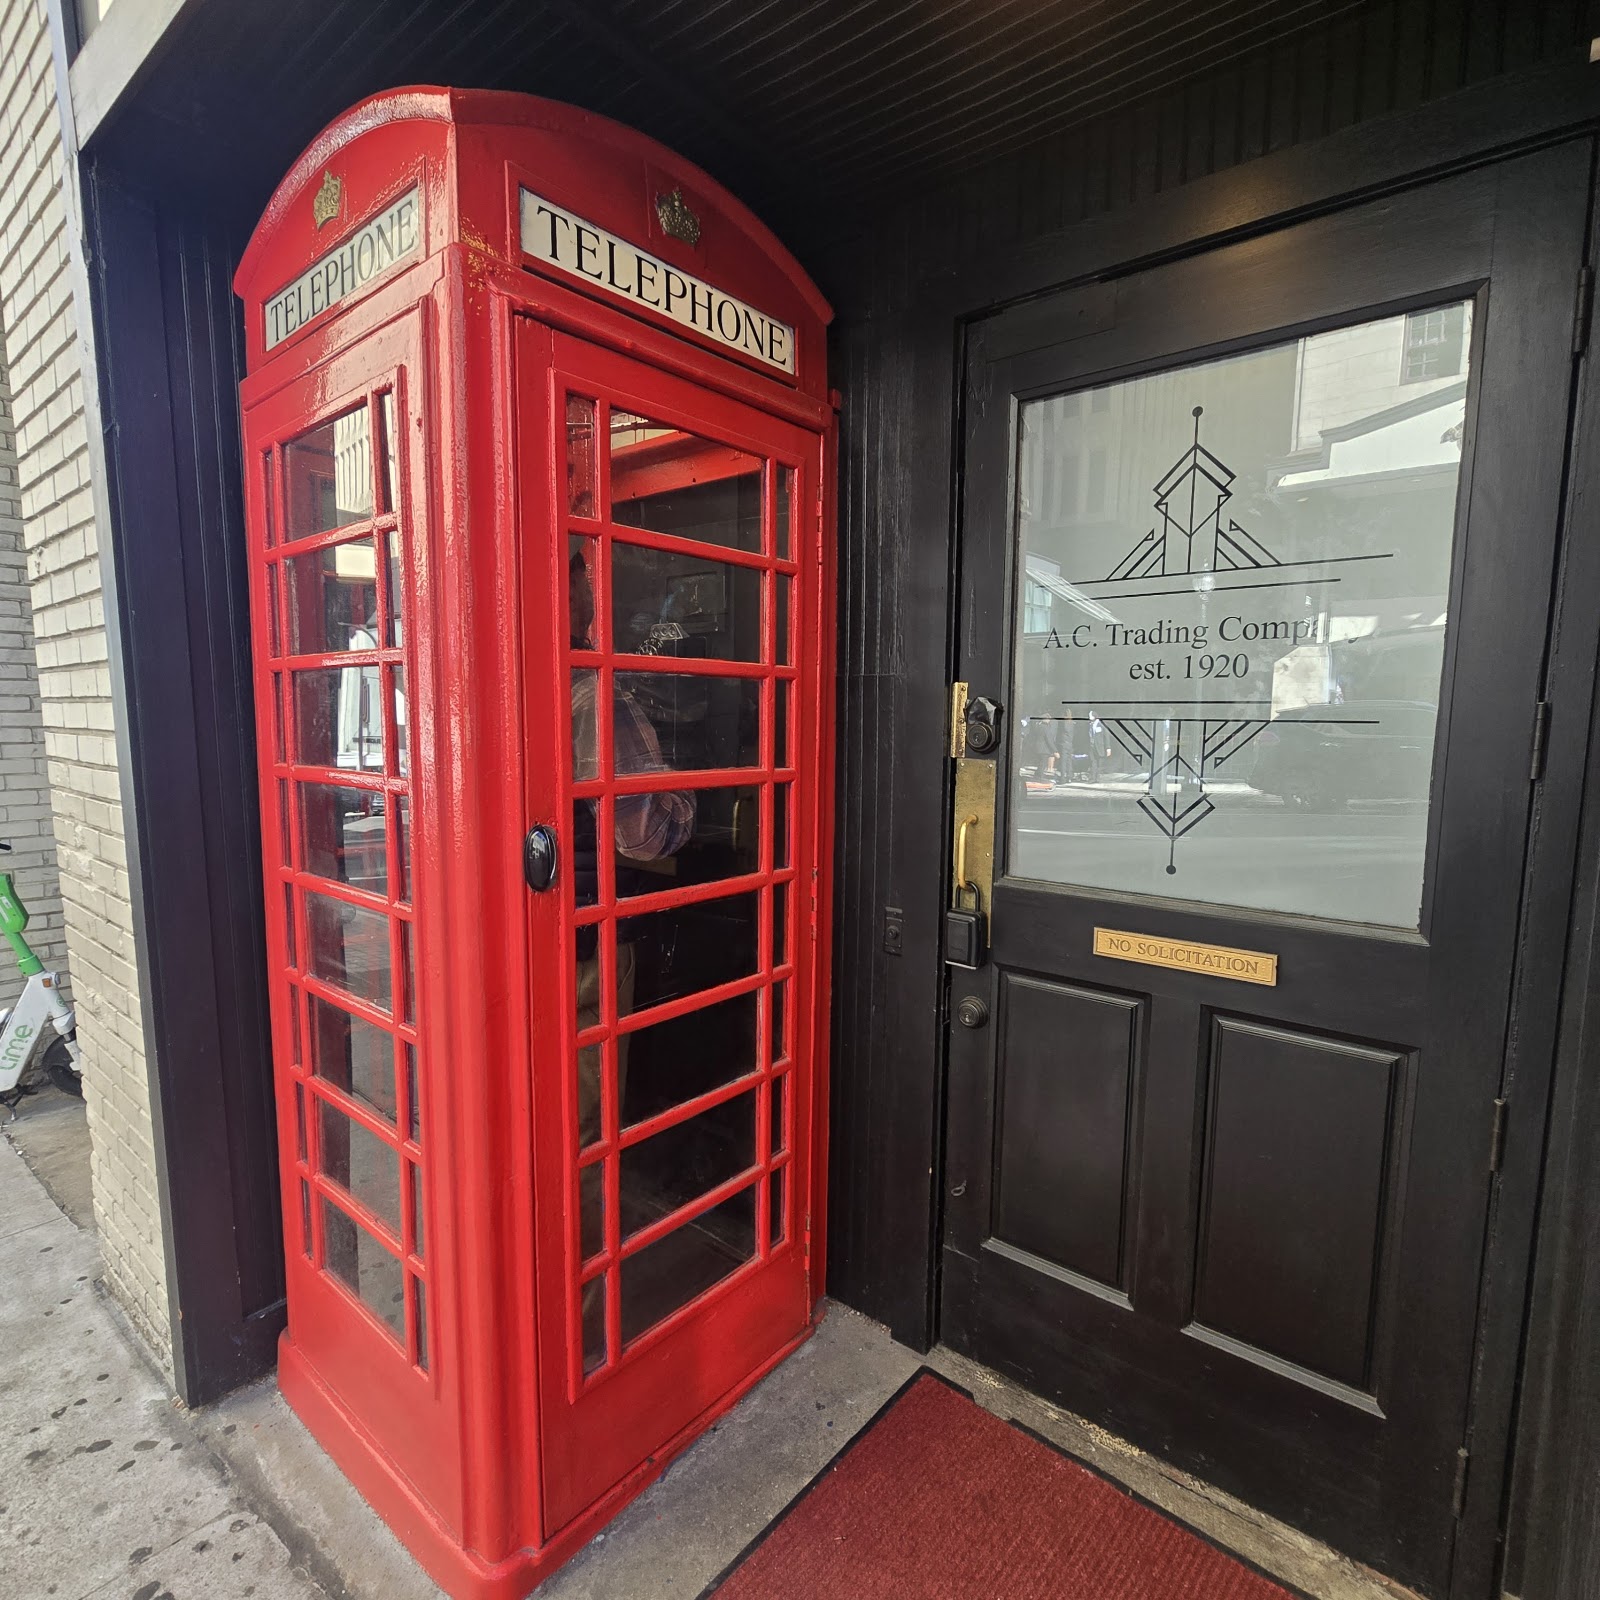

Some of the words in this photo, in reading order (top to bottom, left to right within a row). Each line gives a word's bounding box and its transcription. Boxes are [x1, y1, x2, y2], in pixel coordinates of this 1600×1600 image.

[270, 199, 415, 343] TELEPHONE
[536, 205, 787, 366] TELEPHONE
[1043, 624, 1098, 650] A.C.
[1105, 618, 1209, 650] Trading
[1129, 660, 1171, 680] est.
[1184, 653, 1250, 680] 1920
[1108, 937, 1132, 952] NO
[1137, 942, 1259, 974] SOLICITATION
